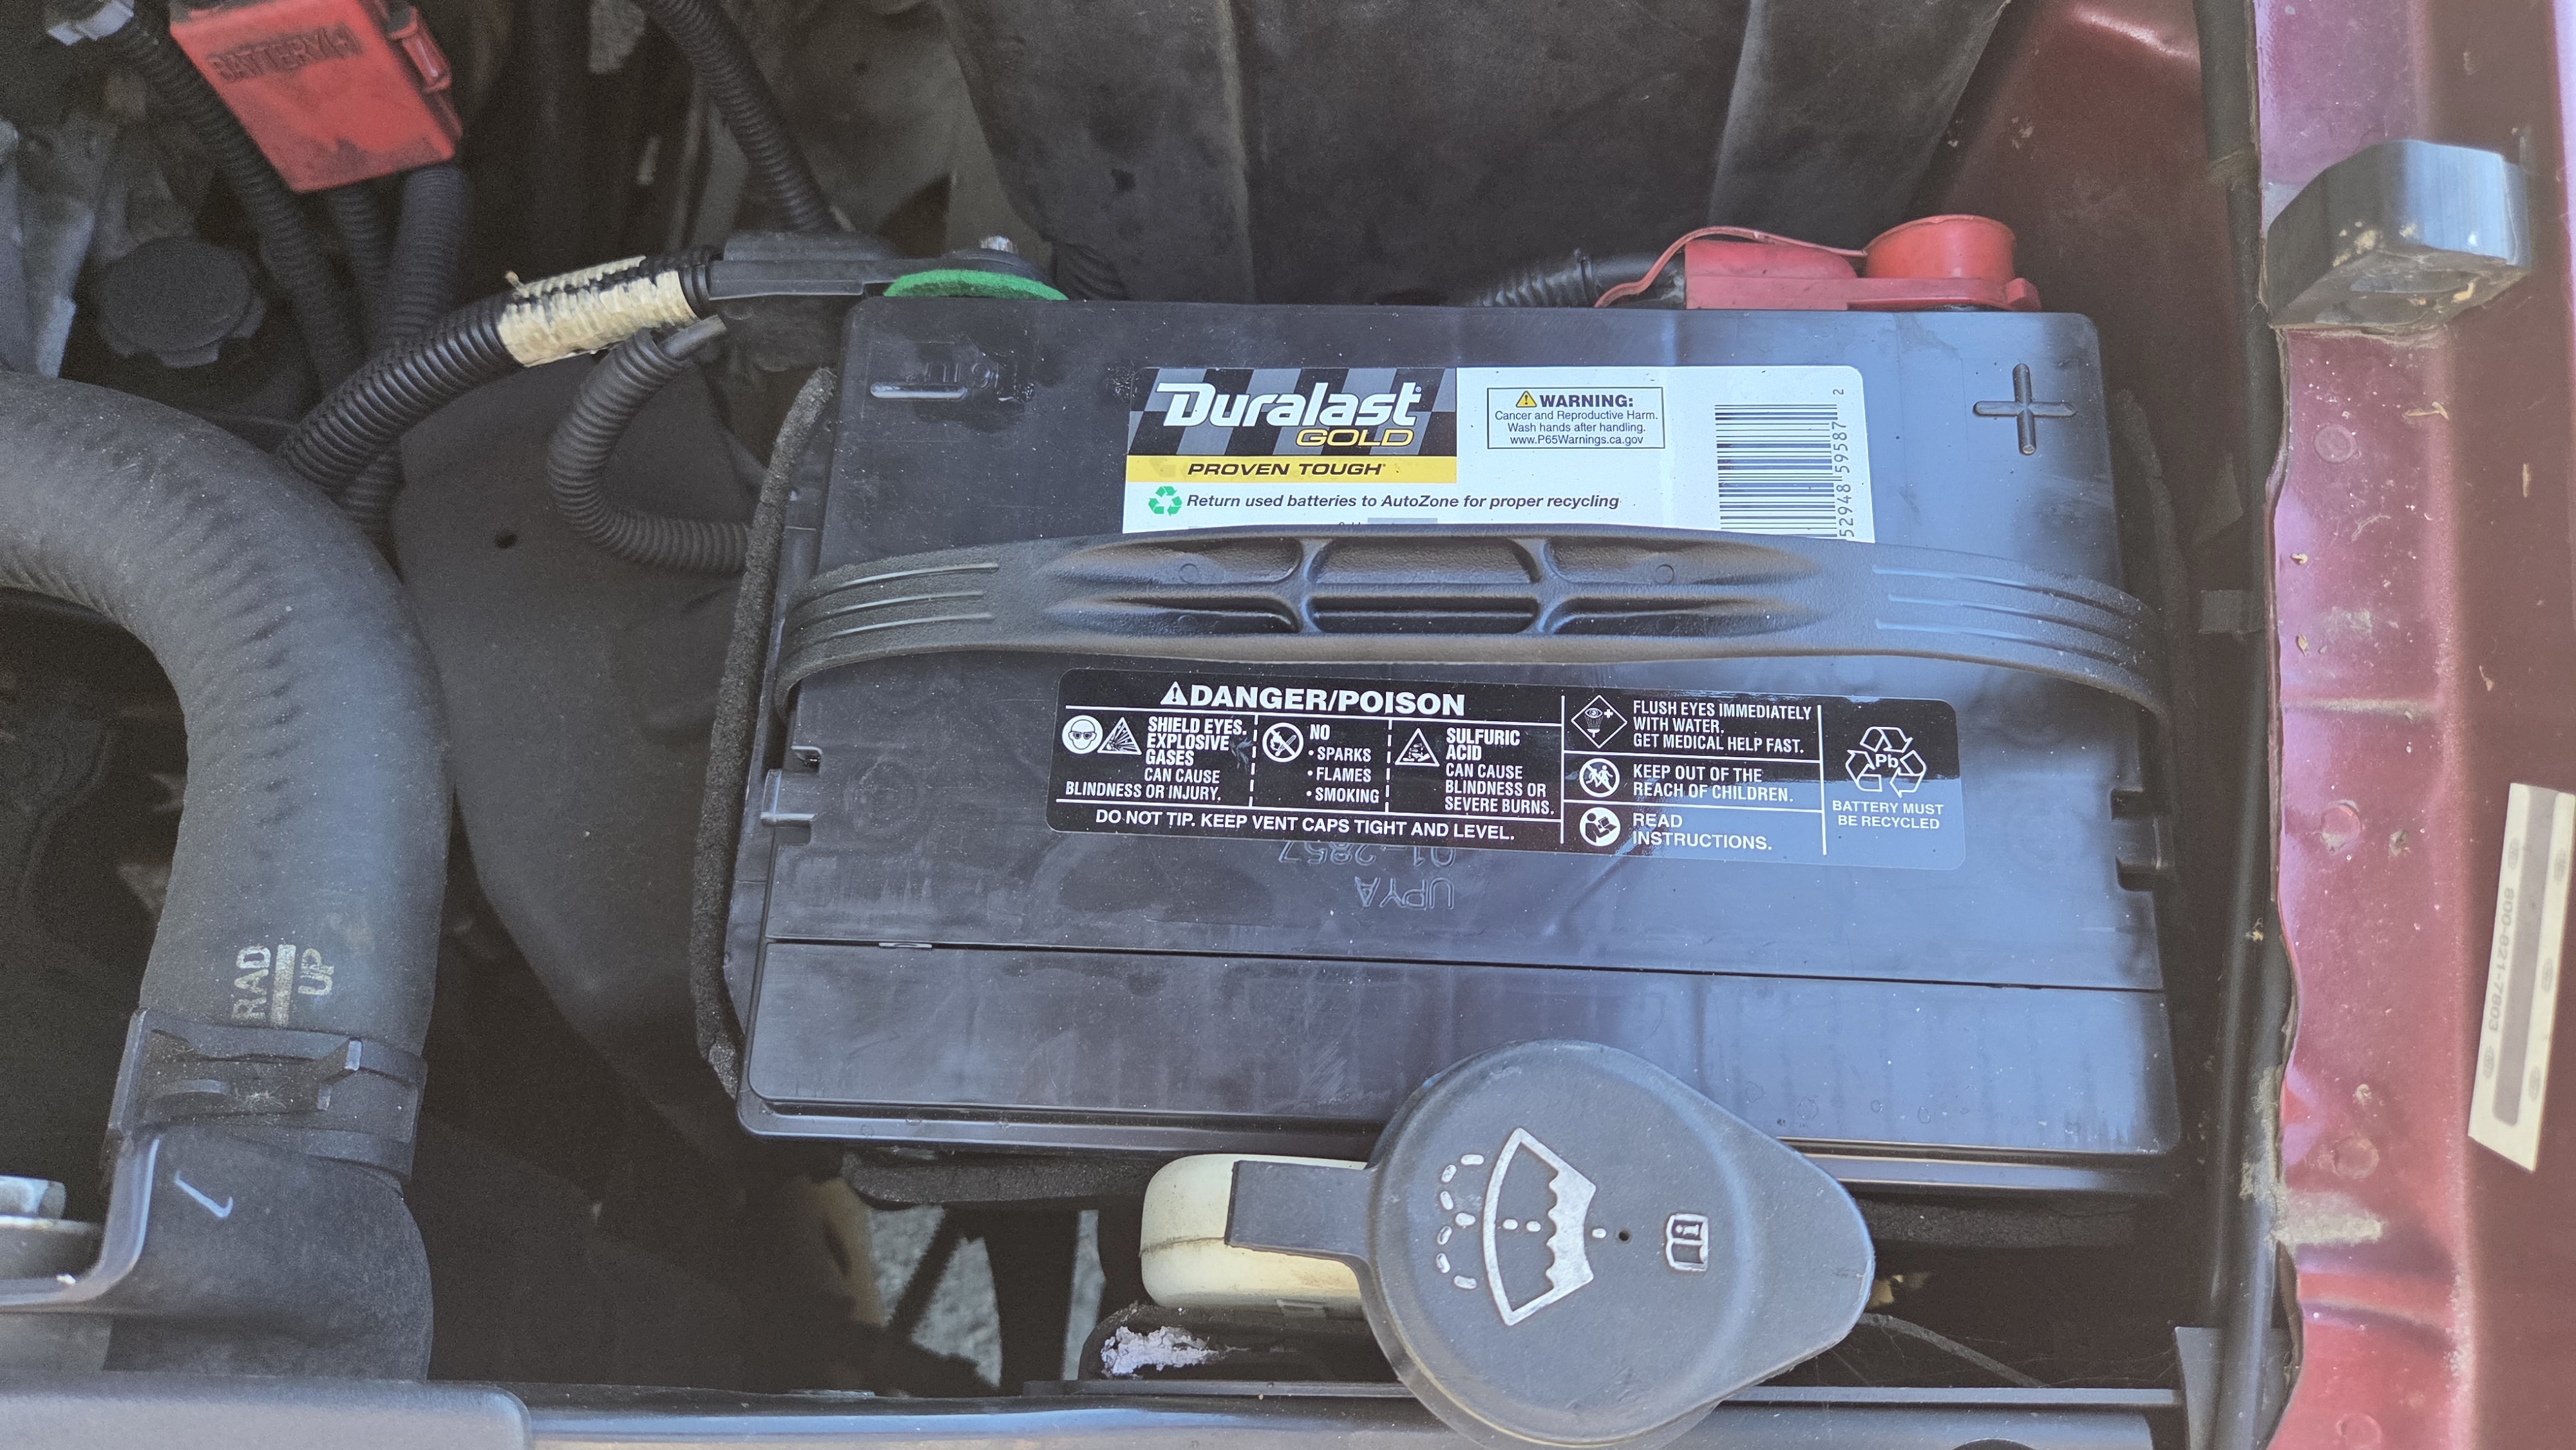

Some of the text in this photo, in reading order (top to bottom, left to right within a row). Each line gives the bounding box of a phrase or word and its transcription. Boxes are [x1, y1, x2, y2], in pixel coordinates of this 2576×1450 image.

[1156, 382, 1422, 427] Duralast
[1540, 395, 1633, 407] WARNING:
[1495, 410, 1658, 422] Cancer and Reproductive Harm.
[1508, 422, 1645, 434] Wash hands after handling.
[1296, 429, 1414, 446] GOLD
[1510, 435, 1643, 446] www.P65Warnings.ca.gov
[1832, 422, 1850, 473] 59587
[1188, 464, 1290, 475] PROVEN
[1187, 495, 1619, 509] Return used batteries to AutoZone for proper recycling
[1836, 484, 1854, 537] 52948
[1190, 684, 1465, 716] DANGER/POISON
[1634, 701, 1811, 720] FLUSH EYES IMMEDIATELY
[1148, 717, 1247, 735] SHIELD EYES.
[1310, 724, 1330, 740] NO
[1633, 717, 1724, 733] WITH WATER.
[1146, 733, 1229, 751] EXPLOSIVE
[1446, 728, 1520, 746] SULFURIC
[1634, 733, 1803, 753] GET MEDICAL HELP FAST.
[1146, 749, 1194, 766] GASES
[1318, 746, 1371, 762] SPARKS
[1446, 744, 1481, 760] ACID
[1876, 754, 1898, 767] Pb
[1144, 767, 1220, 783] CAN CAUSE
[1316, 767, 1371, 782] FLAMES
[1446, 763, 1522, 779] CAN CAUSE
[1634, 764, 1762, 782] KEEP OUT OF THE
[1066, 781, 1220, 800] BLINDNESS OR INJURY.
[1316, 787, 1379, 803] SMOKING
[1446, 780, 1546, 797] BLINDNESS OR
[1634, 782, 1793, 802] REACH OF CHILDREN.
[1445, 796, 1554, 814] SEVERE BURNS.
[1833, 800, 1944, 814] BATTERY MUST
[1096, 809, 1514, 840] DO NOT TIP. KEEP VENT CAPS TIGHT AND LEVEL.
[1633, 813, 1682, 827] READ
[1839, 815, 1939, 829] BE RECYCLED
[1633, 831, 1772, 850] INSTRUCTIONS.
[1355, 876, 1454, 910] UPYA
[2488, 887, 2514, 1031] 800-821-7803
[298, 948, 334, 995] UP
[232, 946, 271, 1019] RAD
